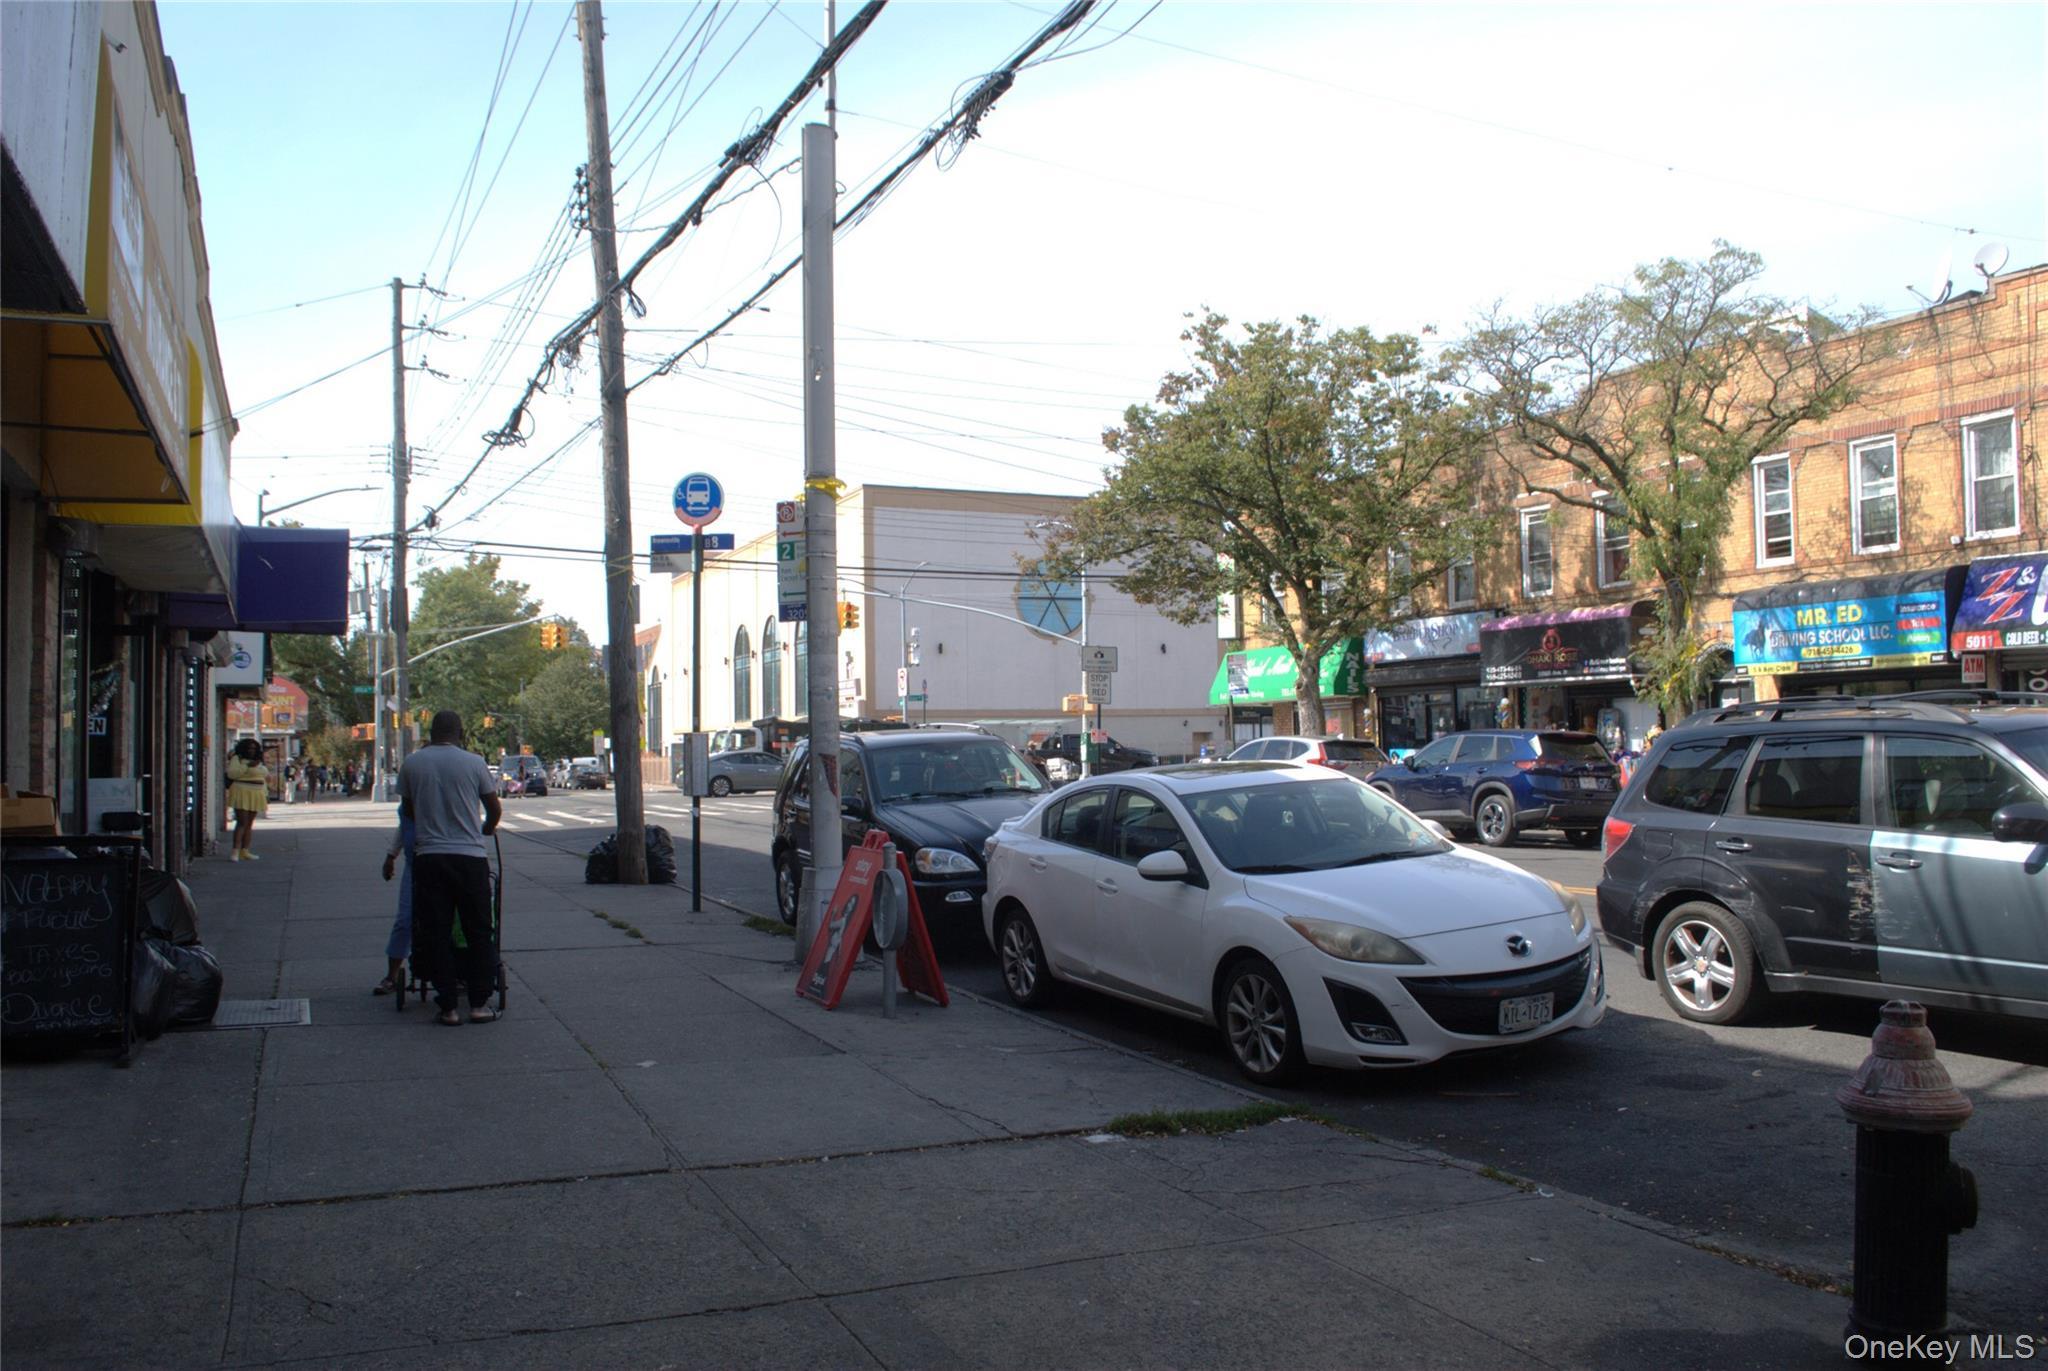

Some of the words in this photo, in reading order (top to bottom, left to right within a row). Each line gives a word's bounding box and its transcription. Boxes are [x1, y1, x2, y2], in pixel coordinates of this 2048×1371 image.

[1796, 608, 1832, 627] MR.
[1836, 603, 1863, 623] ED
[1769, 630, 1816, 648] DRIVING
[1818, 627, 1866, 645] SCHOOL
[1869, 624, 1894, 641] LLC.
[1965, 634, 1993, 649] 5011
[2005, 631, 2021, 646] COLD
[2022, 630, 2039, 645] BEER
[1346, 652, 1359, 693] NAILS
[1965, 657, 1984, 673] ATM
[1090, 674, 1108, 682] STOP
[1092, 688, 1106, 696] RED
